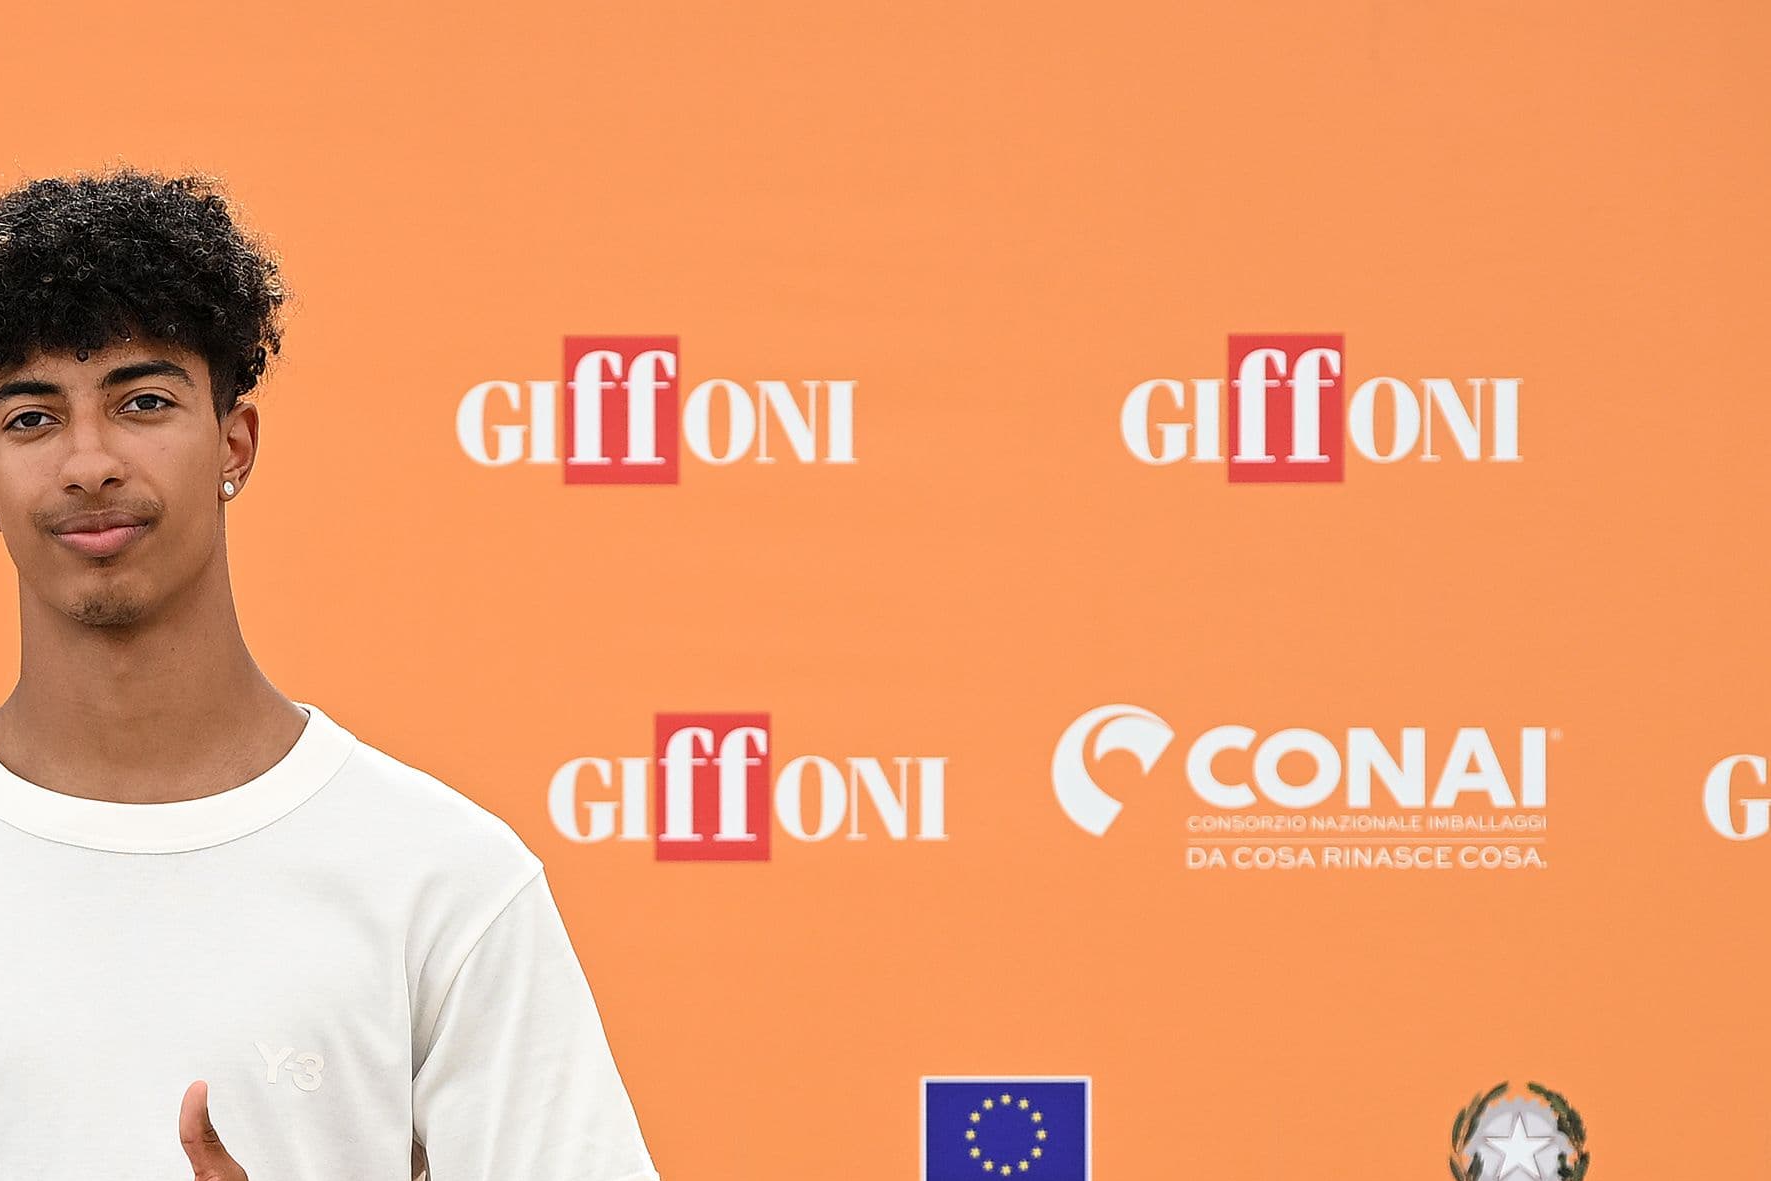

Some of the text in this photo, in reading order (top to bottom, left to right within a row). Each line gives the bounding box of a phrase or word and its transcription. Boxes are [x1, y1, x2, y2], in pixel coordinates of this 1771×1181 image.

[457, 352, 857, 468] GIffONI
[1121, 350, 1524, 466] GIffONI
[548, 728, 949, 845] GIffONI
[1185, 725, 1547, 808] CONAI
[1187, 815, 1547, 832] CONSORZIO NAZIONALE IMBALLAGGI
[1187, 846, 1547, 869] DA COSA RINASCE COSA.
[253, 1040, 325, 1092] Y-3
